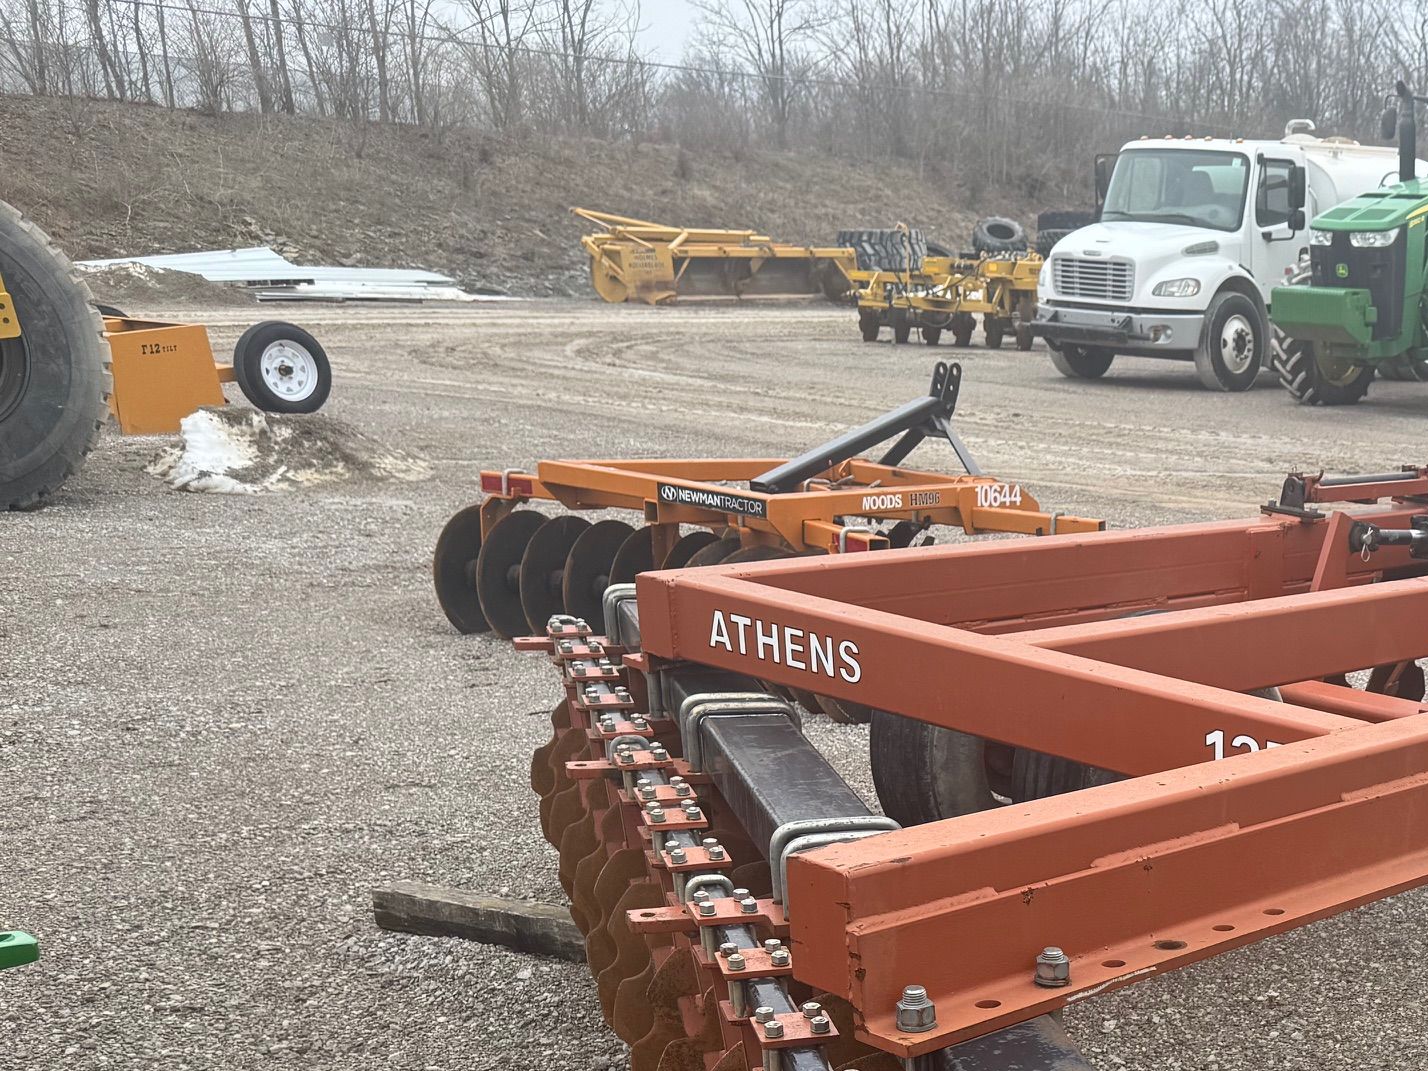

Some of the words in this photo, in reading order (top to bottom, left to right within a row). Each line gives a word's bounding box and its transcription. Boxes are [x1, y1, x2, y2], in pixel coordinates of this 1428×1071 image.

[910, 492, 940, 506] HM96
[975, 484, 1022, 507] 10644
[709, 610, 862, 684] ATHENS
